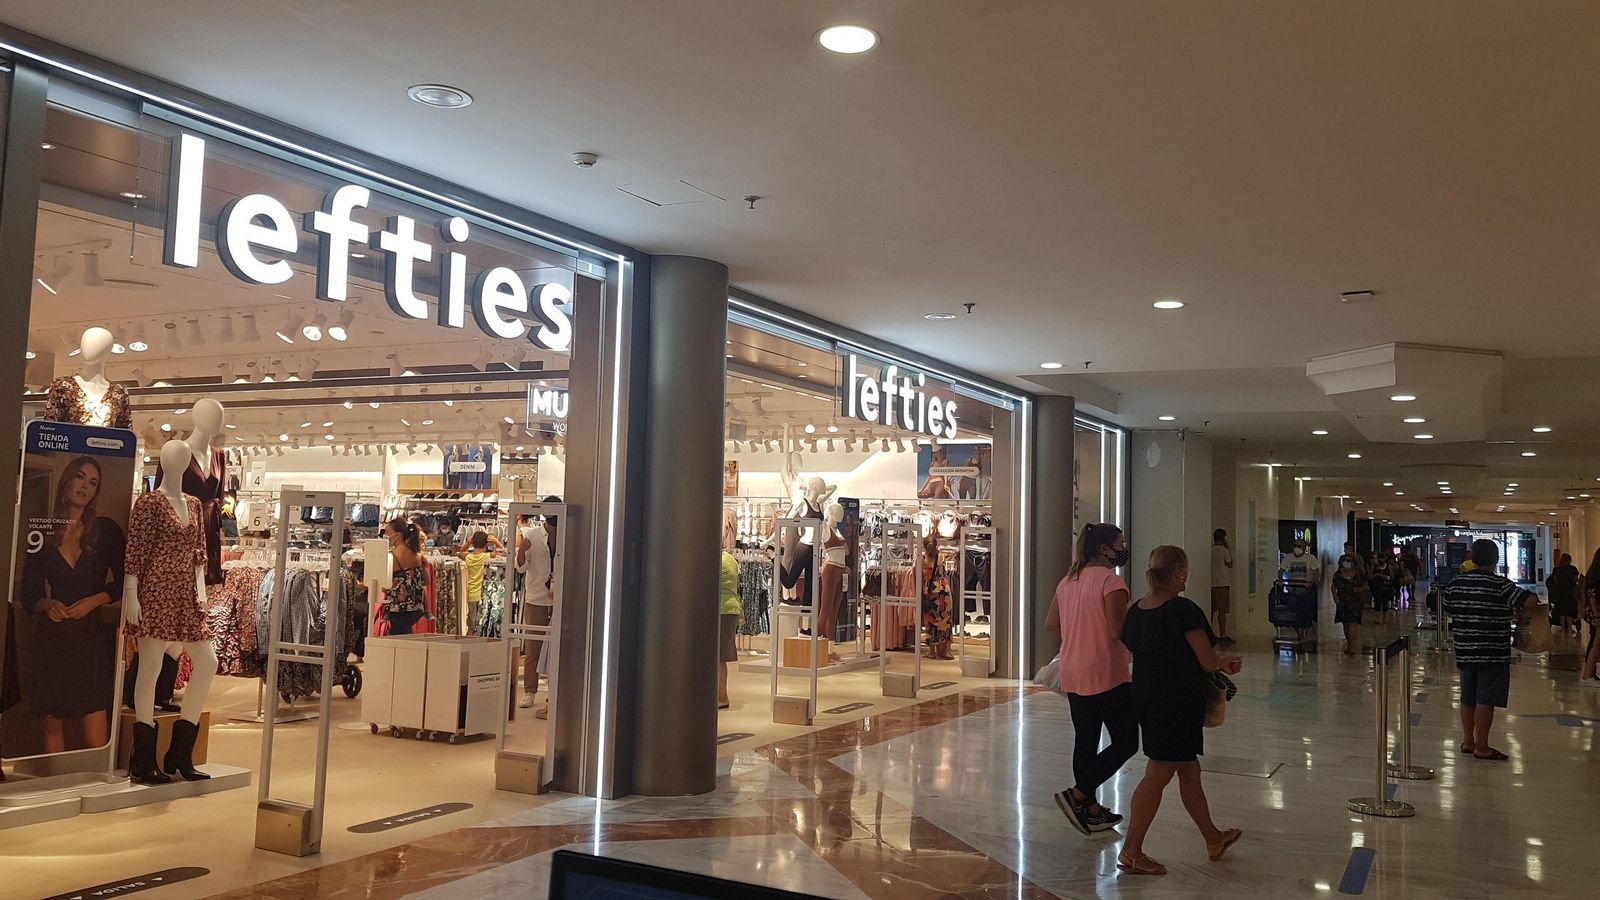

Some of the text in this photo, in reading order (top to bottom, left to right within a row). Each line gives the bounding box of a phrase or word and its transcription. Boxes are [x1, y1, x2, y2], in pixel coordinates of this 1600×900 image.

[163, 132, 573, 351] lefties
[842, 353, 957, 440] lefties
[553, 421, 567, 431] WO
[39, 433, 69, 442] TIENDA
[38, 440, 69, 450] ONLINE
[91, 439, 119, 447] lefties.com
[254, 476, 260, 486] 4
[253, 516, 261, 526] 6
[27, 531, 44, 553] 9
[91, 881, 146, 896] SALIDA
